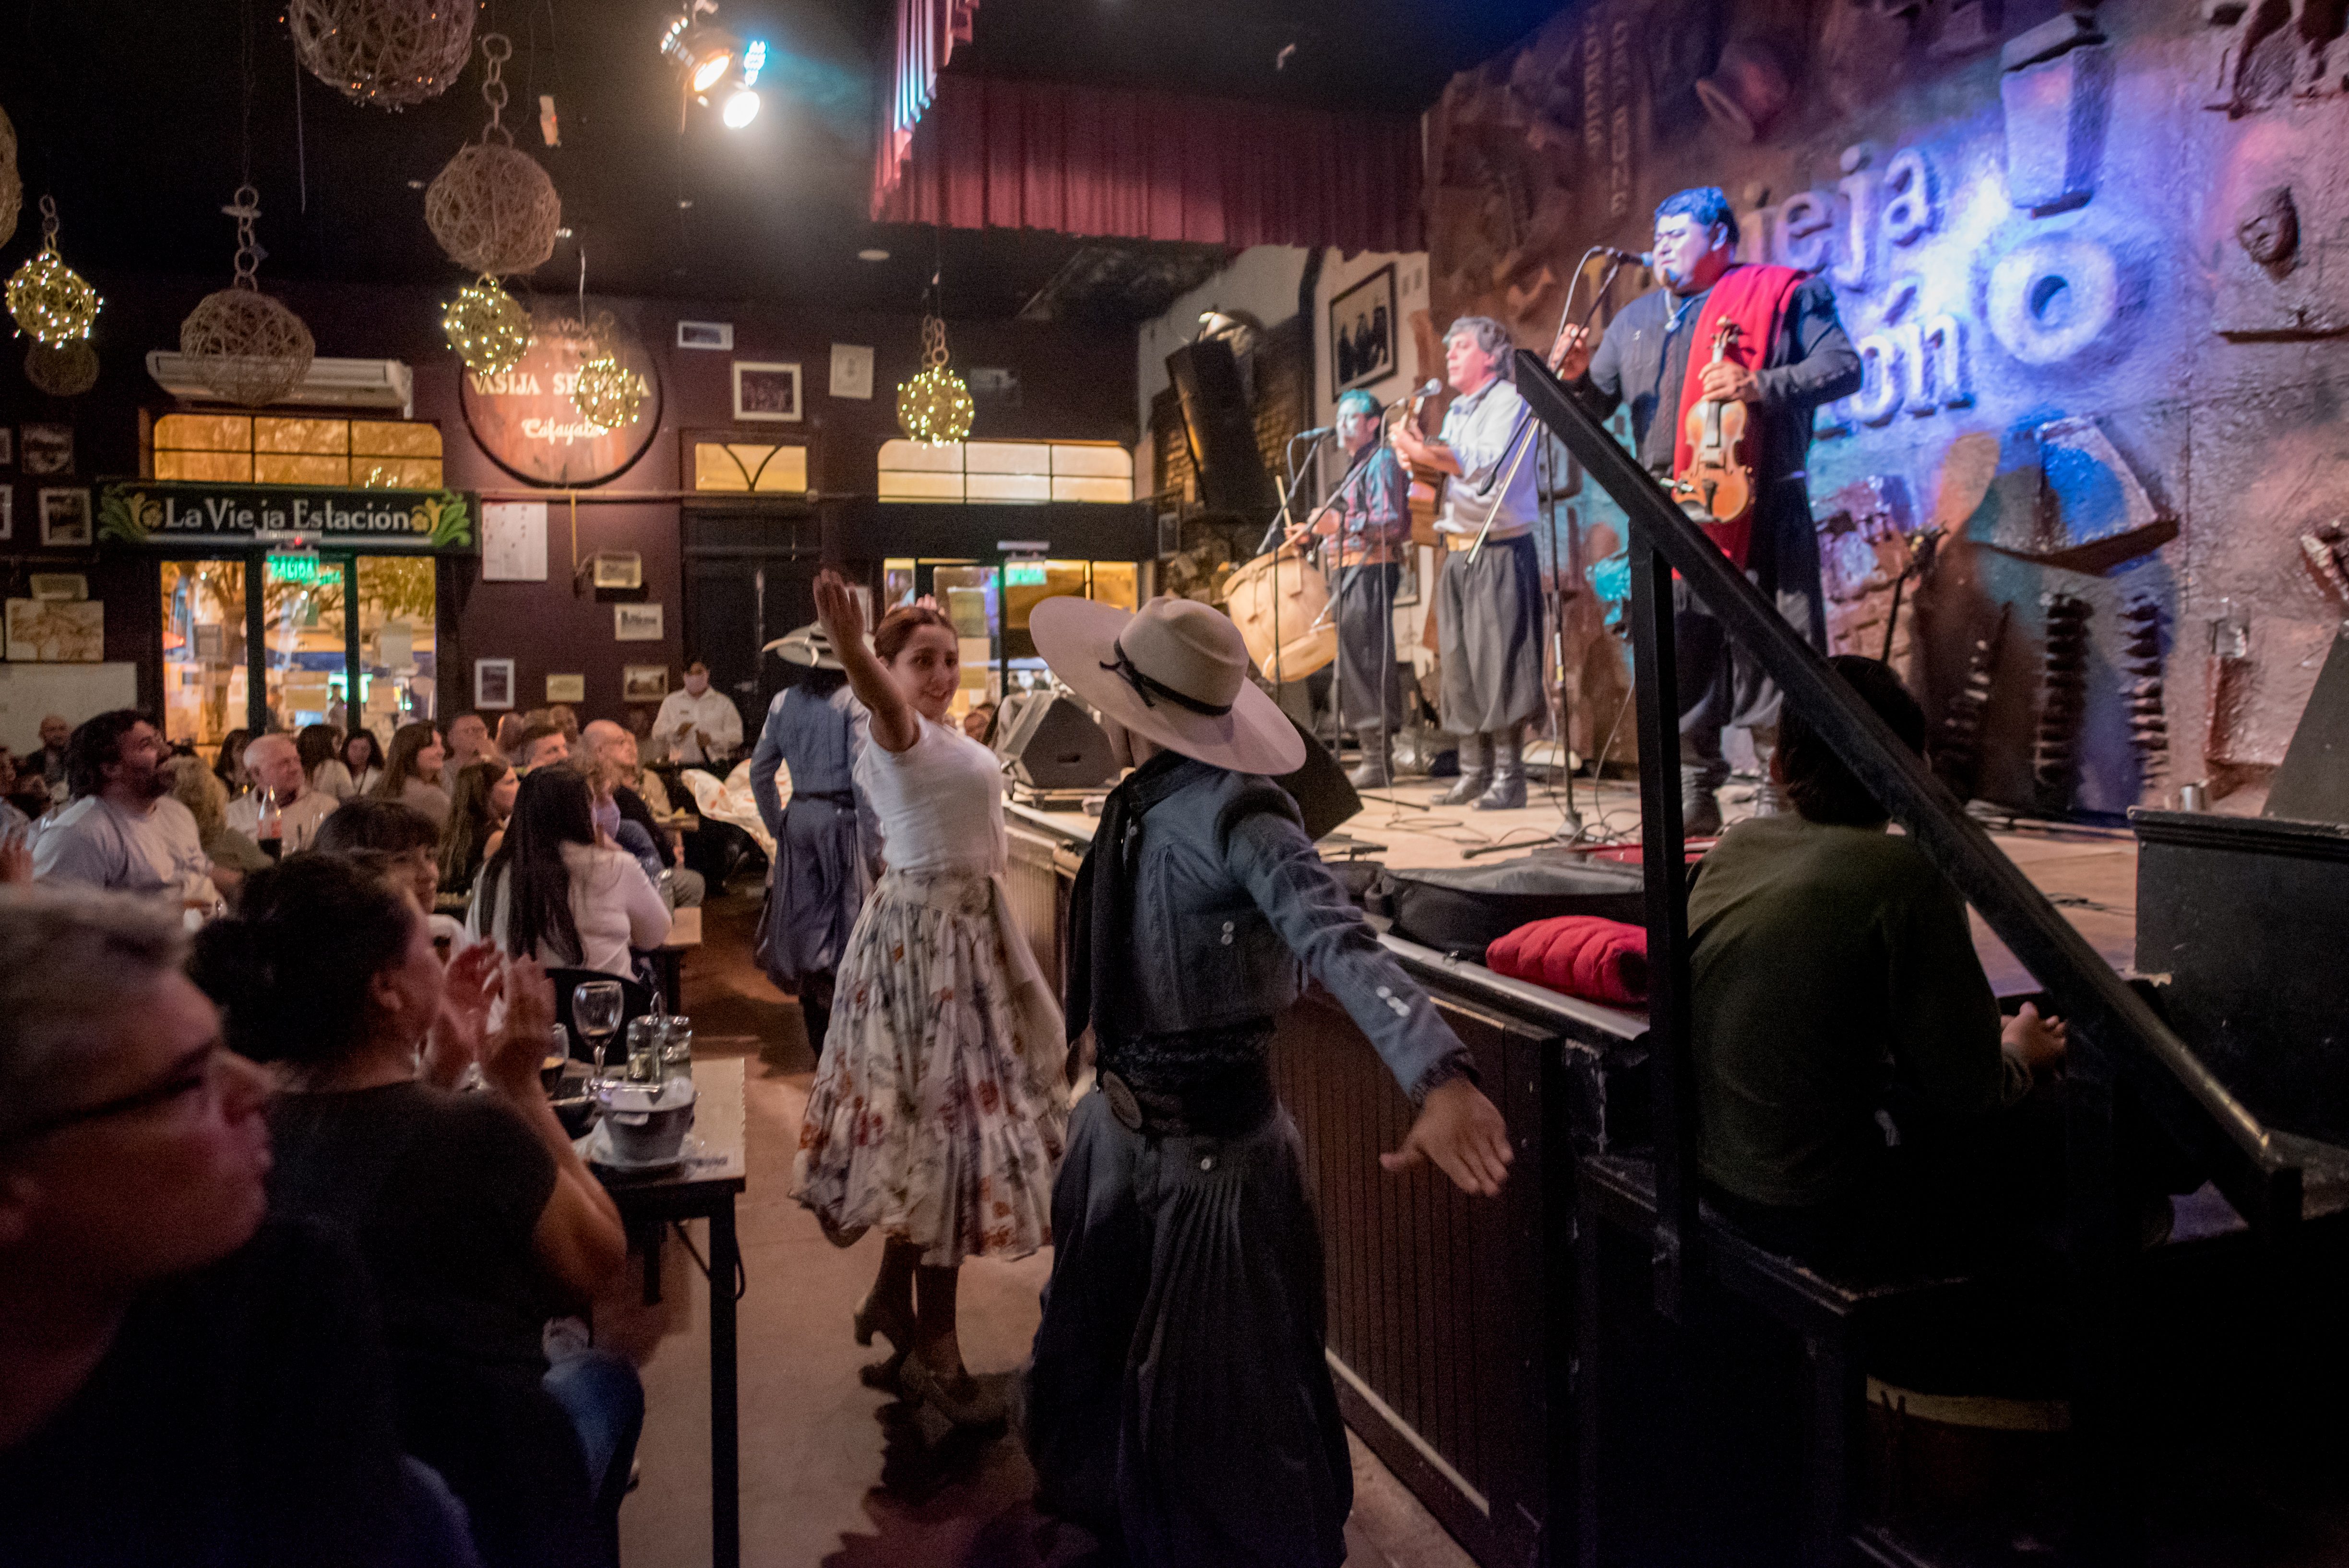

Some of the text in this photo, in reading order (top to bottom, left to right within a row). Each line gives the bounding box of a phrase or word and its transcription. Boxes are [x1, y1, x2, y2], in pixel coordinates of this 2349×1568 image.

[1738, 143, 1930, 290] ieja
[468, 372, 651, 397] VASIJA SETA
[165, 497, 203, 529] La
